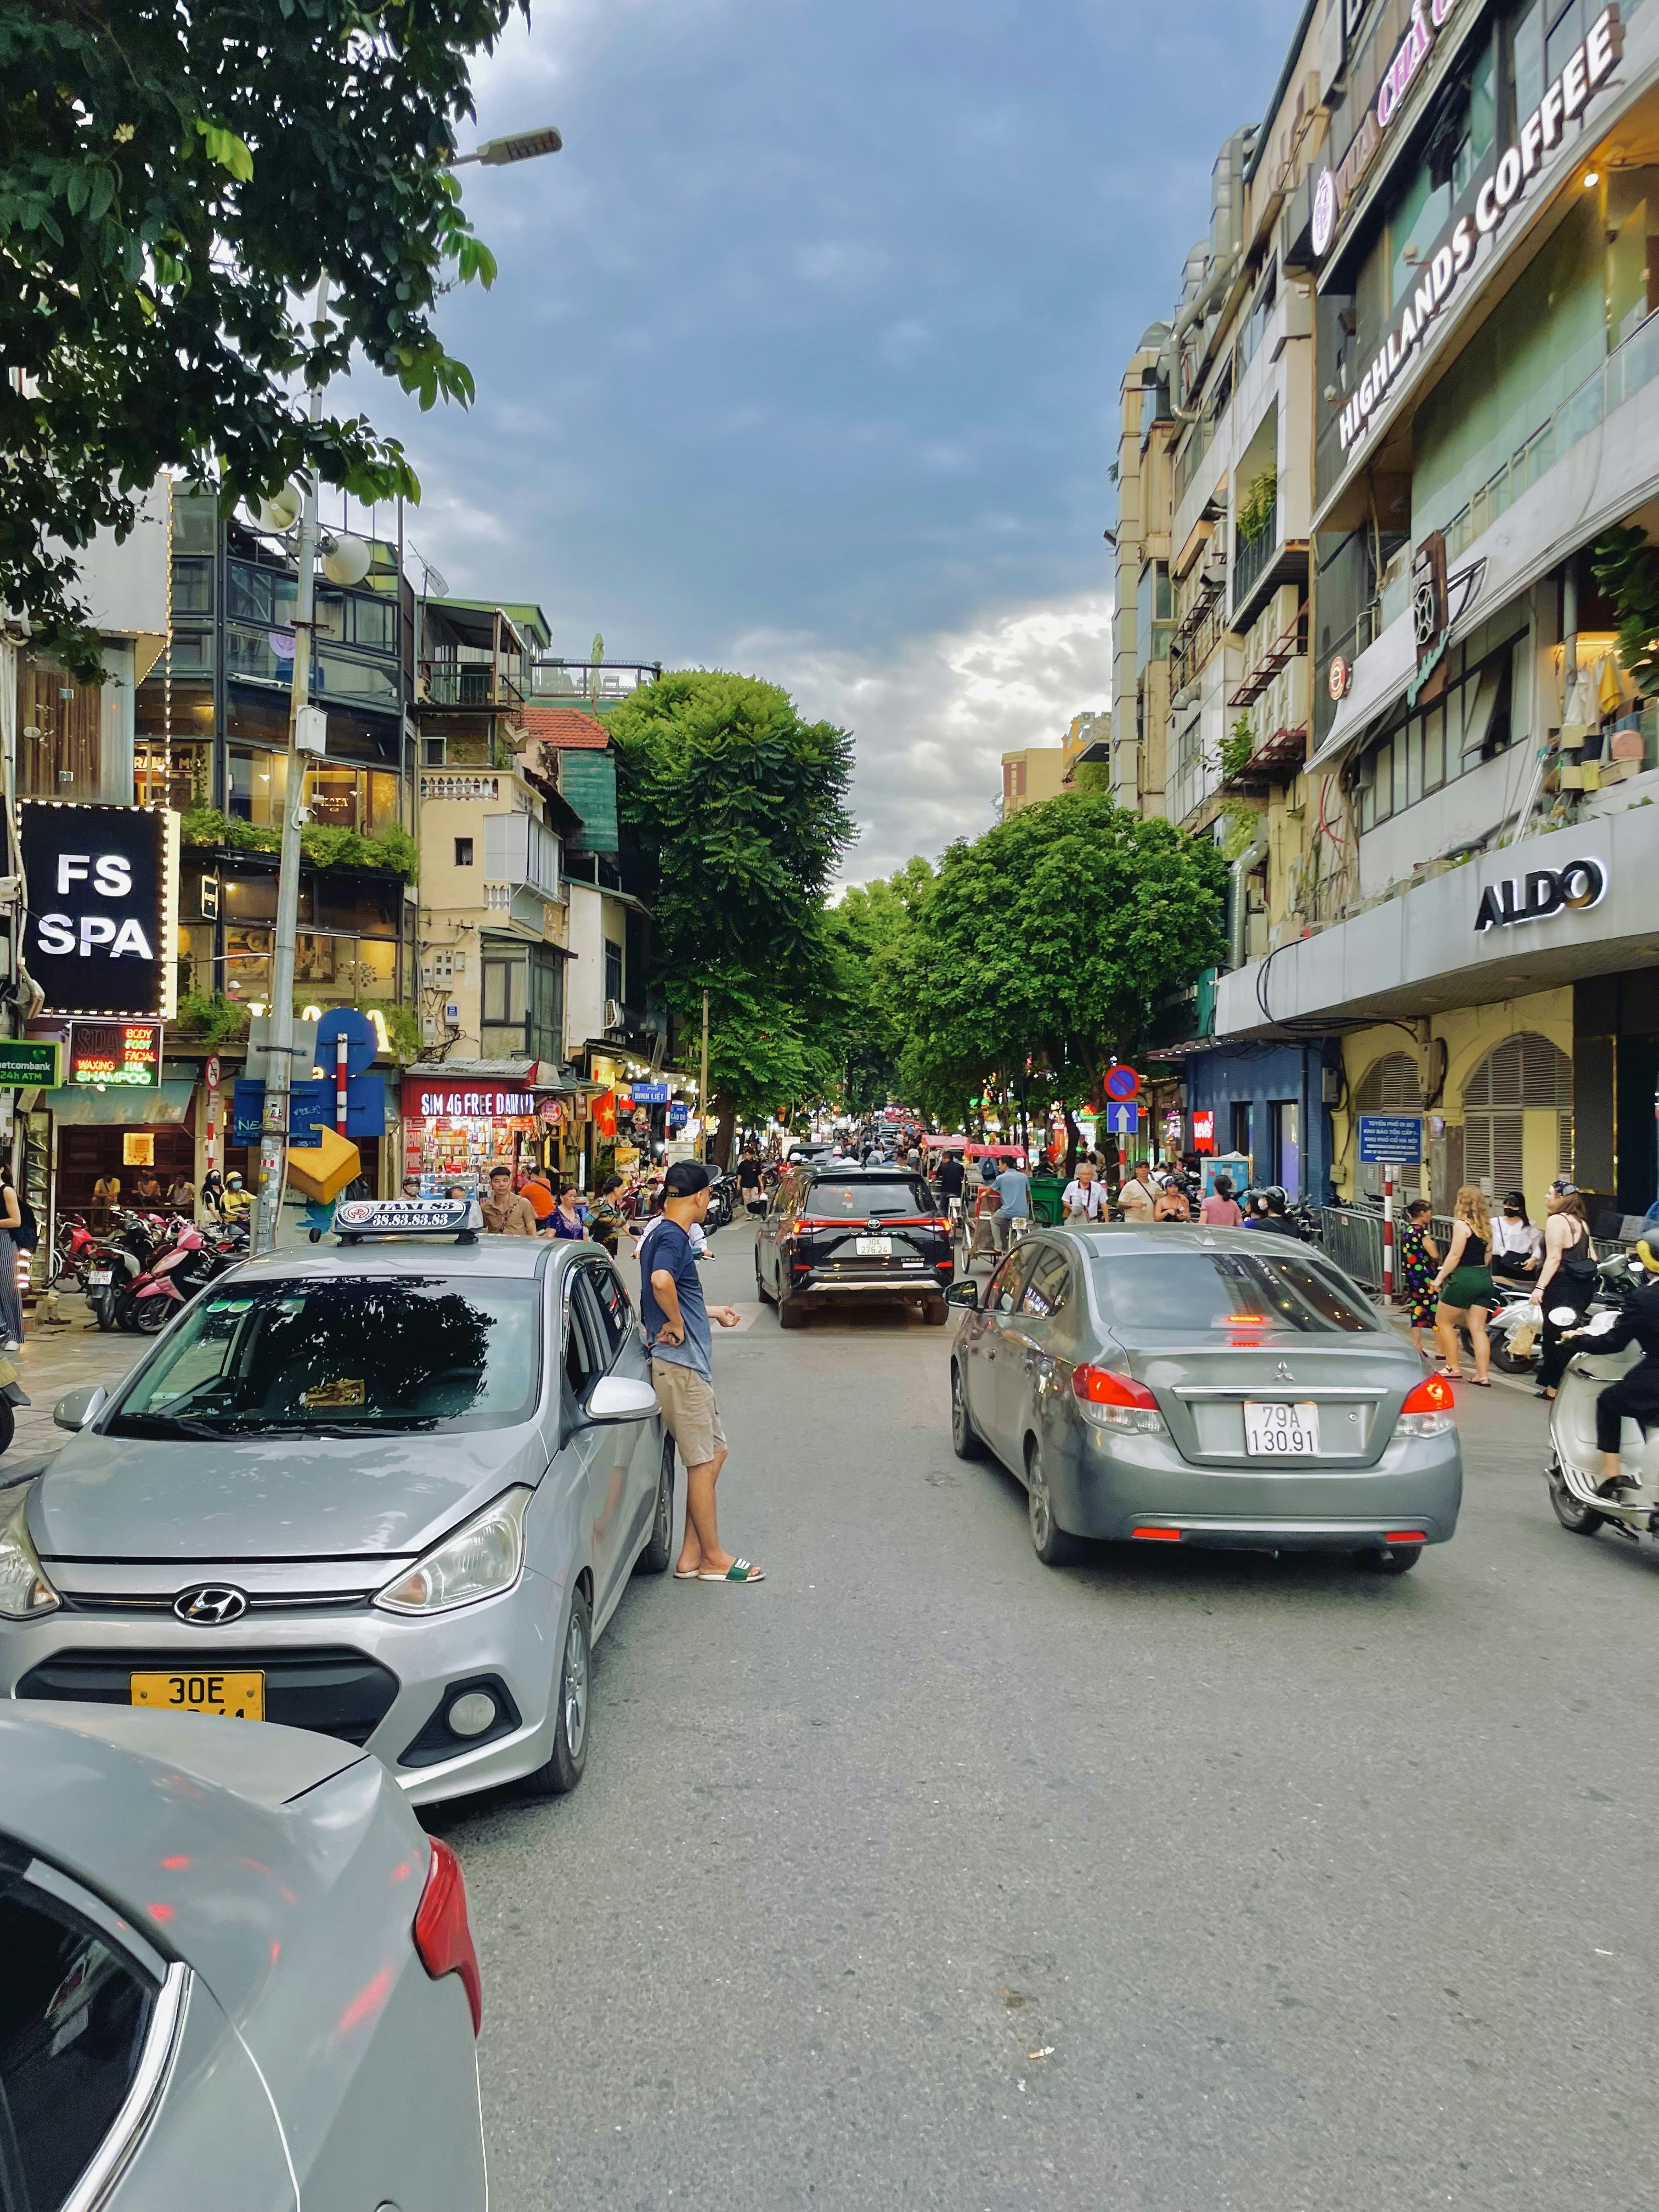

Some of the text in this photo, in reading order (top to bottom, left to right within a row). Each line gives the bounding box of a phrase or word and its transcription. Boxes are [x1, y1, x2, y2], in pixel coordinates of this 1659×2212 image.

[1339, 8, 1613, 452] HIGHLANDS COFFEE
[57, 854, 132, 897] FS
[1474, 859, 1603, 931] ALDO
[37, 913, 154, 960] SPA
[126, 1028, 153, 1039] BODY
[125, 1039, 153, 1049] FOOT
[125, 1051, 157, 1062] FACIAL
[77, 1059, 115, 1070] WAXING
[123, 1062, 146, 1072] NAIL
[0, 1071, 20, 1080] 24h
[76, 1070, 151, 1084] SHAMPOO
[421, 1093, 443, 1115] SIM
[446, 1093, 461, 1115] 4G
[464, 1093, 492, 1115] FREE
[430, 1201, 454, 1210] 83
[372, 1213, 448, 1226] 38.83.83.83
[866, 1238, 881, 1246] 30K
[1262, 1406, 1300, 1427] 79A
[1252, 1430, 1313, 1452] 130.91
[168, 1677, 225, 1704] 30E
